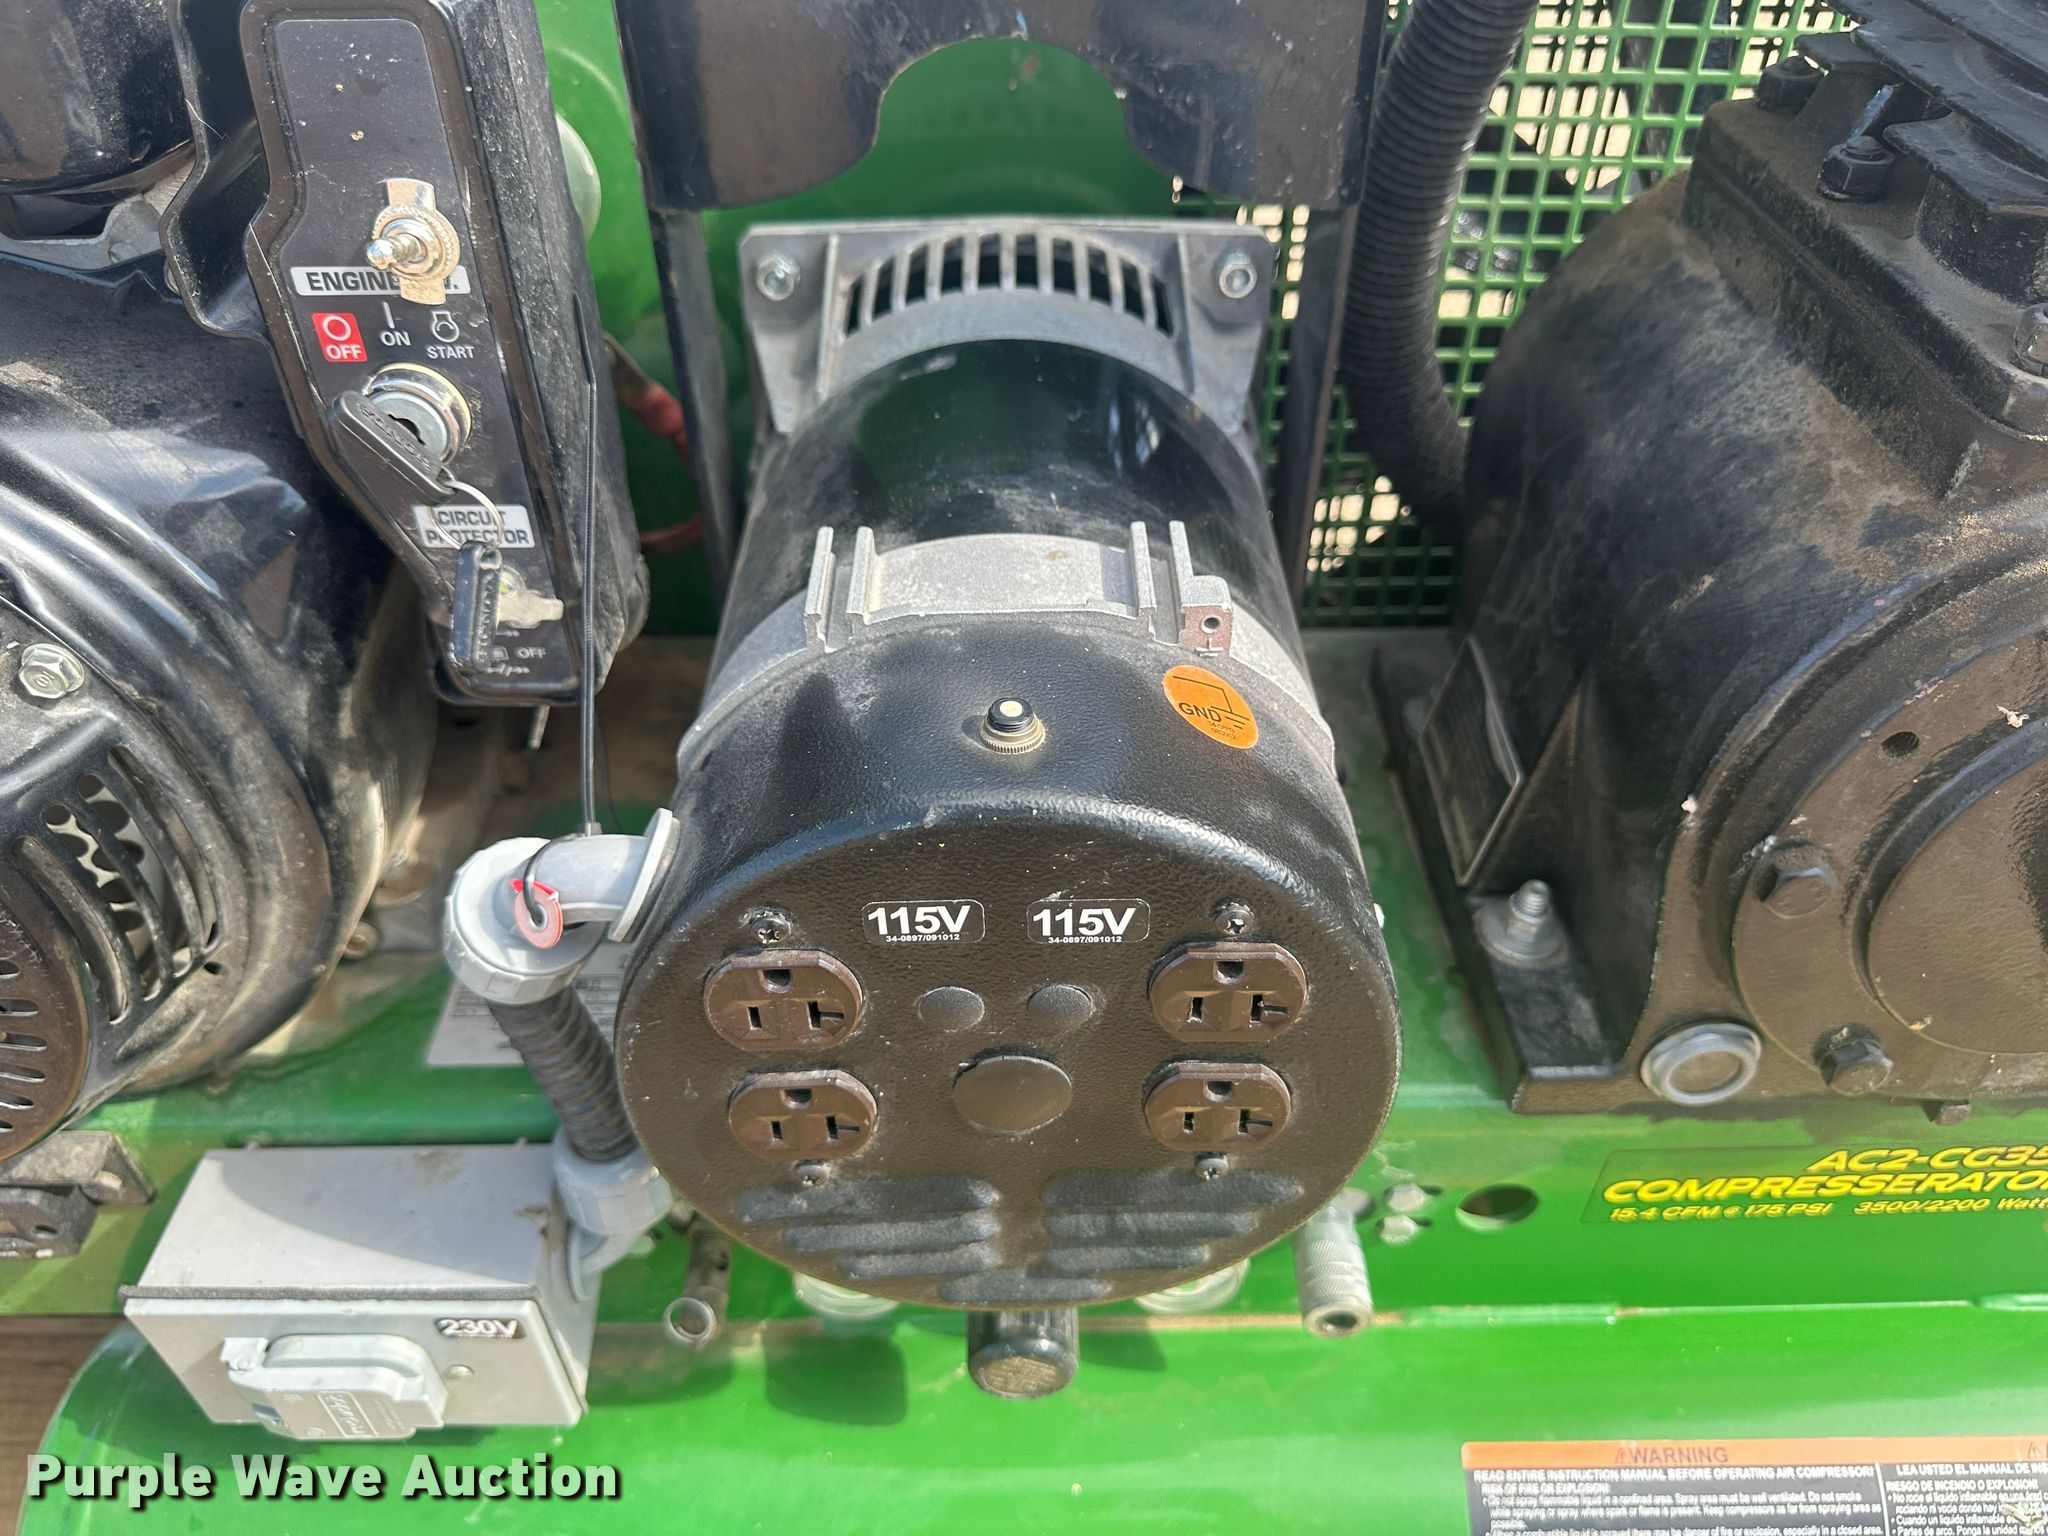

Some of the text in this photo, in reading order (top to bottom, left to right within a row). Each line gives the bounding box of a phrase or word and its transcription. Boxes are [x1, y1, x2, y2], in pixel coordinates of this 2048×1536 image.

[381, 331, 411, 346] ON
[326, 345, 364, 360] OFF
[427, 346, 475, 359] START
[518, 647, 546, 659] OFF
[1179, 702, 1222, 722] GND
[868, 905, 971, 936] 115V
[1033, 907, 1137, 937] 115V
[886, 933, 960, 942] 34-0897/091012
[1048, 935, 1122, 944] 34-0897/091012
[1662, 1204, 1721, 1220] CFM
[1745, 1203, 1786, 1218] 175
[1787, 1202, 1834, 1217] PSI
[1854, 1198, 1992, 1215] 3500/2200
[438, 1319, 518, 1337] 230V
[1629, 1447, 1728, 1463] WARNING
[1547, 1469, 1619, 1481] INSTRUCTION
[1620, 1468, 1666, 1480] MANUAL
[1667, 1467, 1712, 1480] BEFORE
[1713, 1467, 1775, 1479] OPERATING
[1777, 1466, 1795, 1478] AIR
[1896, 1464, 1918, 1476] LEA
[1918, 1464, 1953, 1475] USTED
[1954, 1464, 1969, 1475] EL
[1969, 1463, 2014, 1474] MANUAL
[2015, 1463, 2031, 1473] DE
[1886, 1480, 1920, 1492] RIESGO
[1920, 1479, 1934, 1491] DE
[1934, 1479, 1976, 1491] INCENDIO
